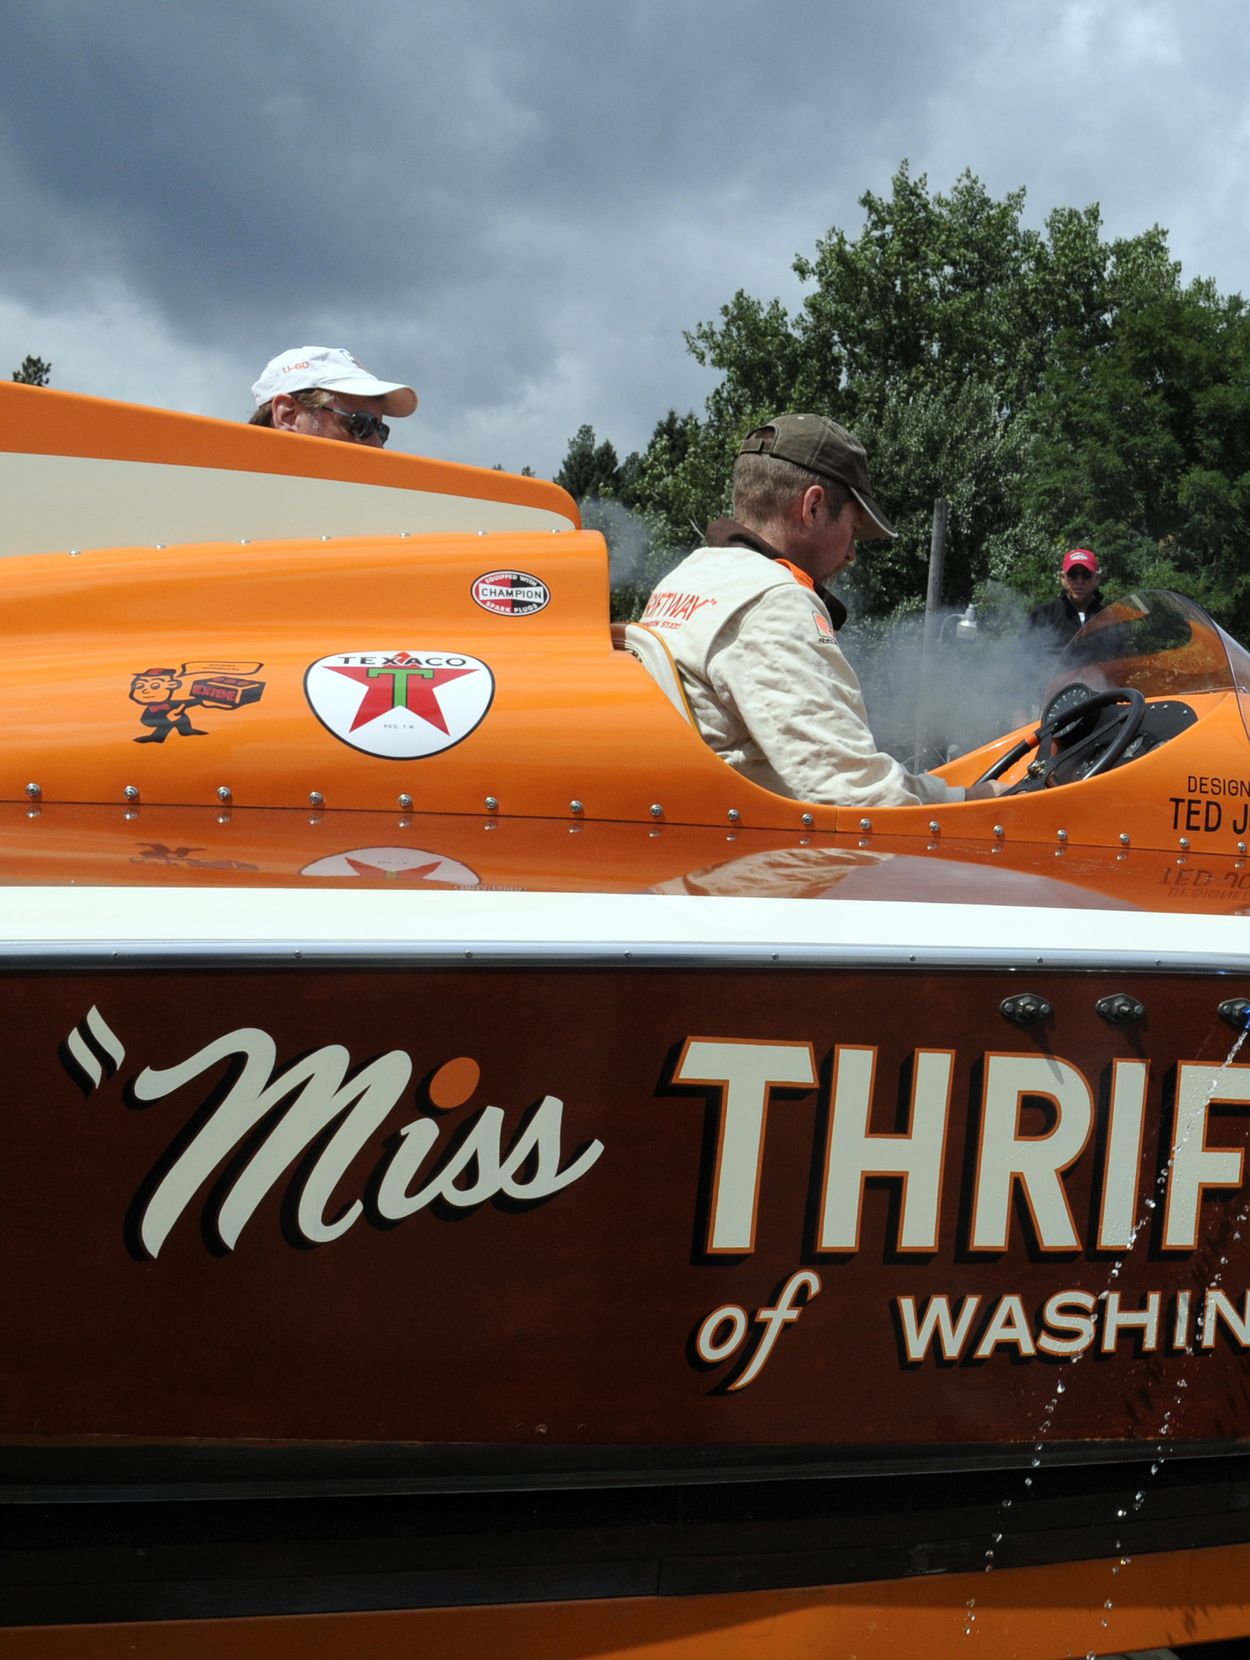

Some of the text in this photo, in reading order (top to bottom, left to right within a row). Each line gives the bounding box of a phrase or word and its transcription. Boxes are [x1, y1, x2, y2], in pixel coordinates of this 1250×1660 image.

[480, 587, 543, 599] CHAMPION
[486, 601, 539, 613] SPARK PLUGS
[338, 655, 467, 667] TEXACO
[1169, 797, 1223, 833] TED
[695, 1268, 823, 1392] of
